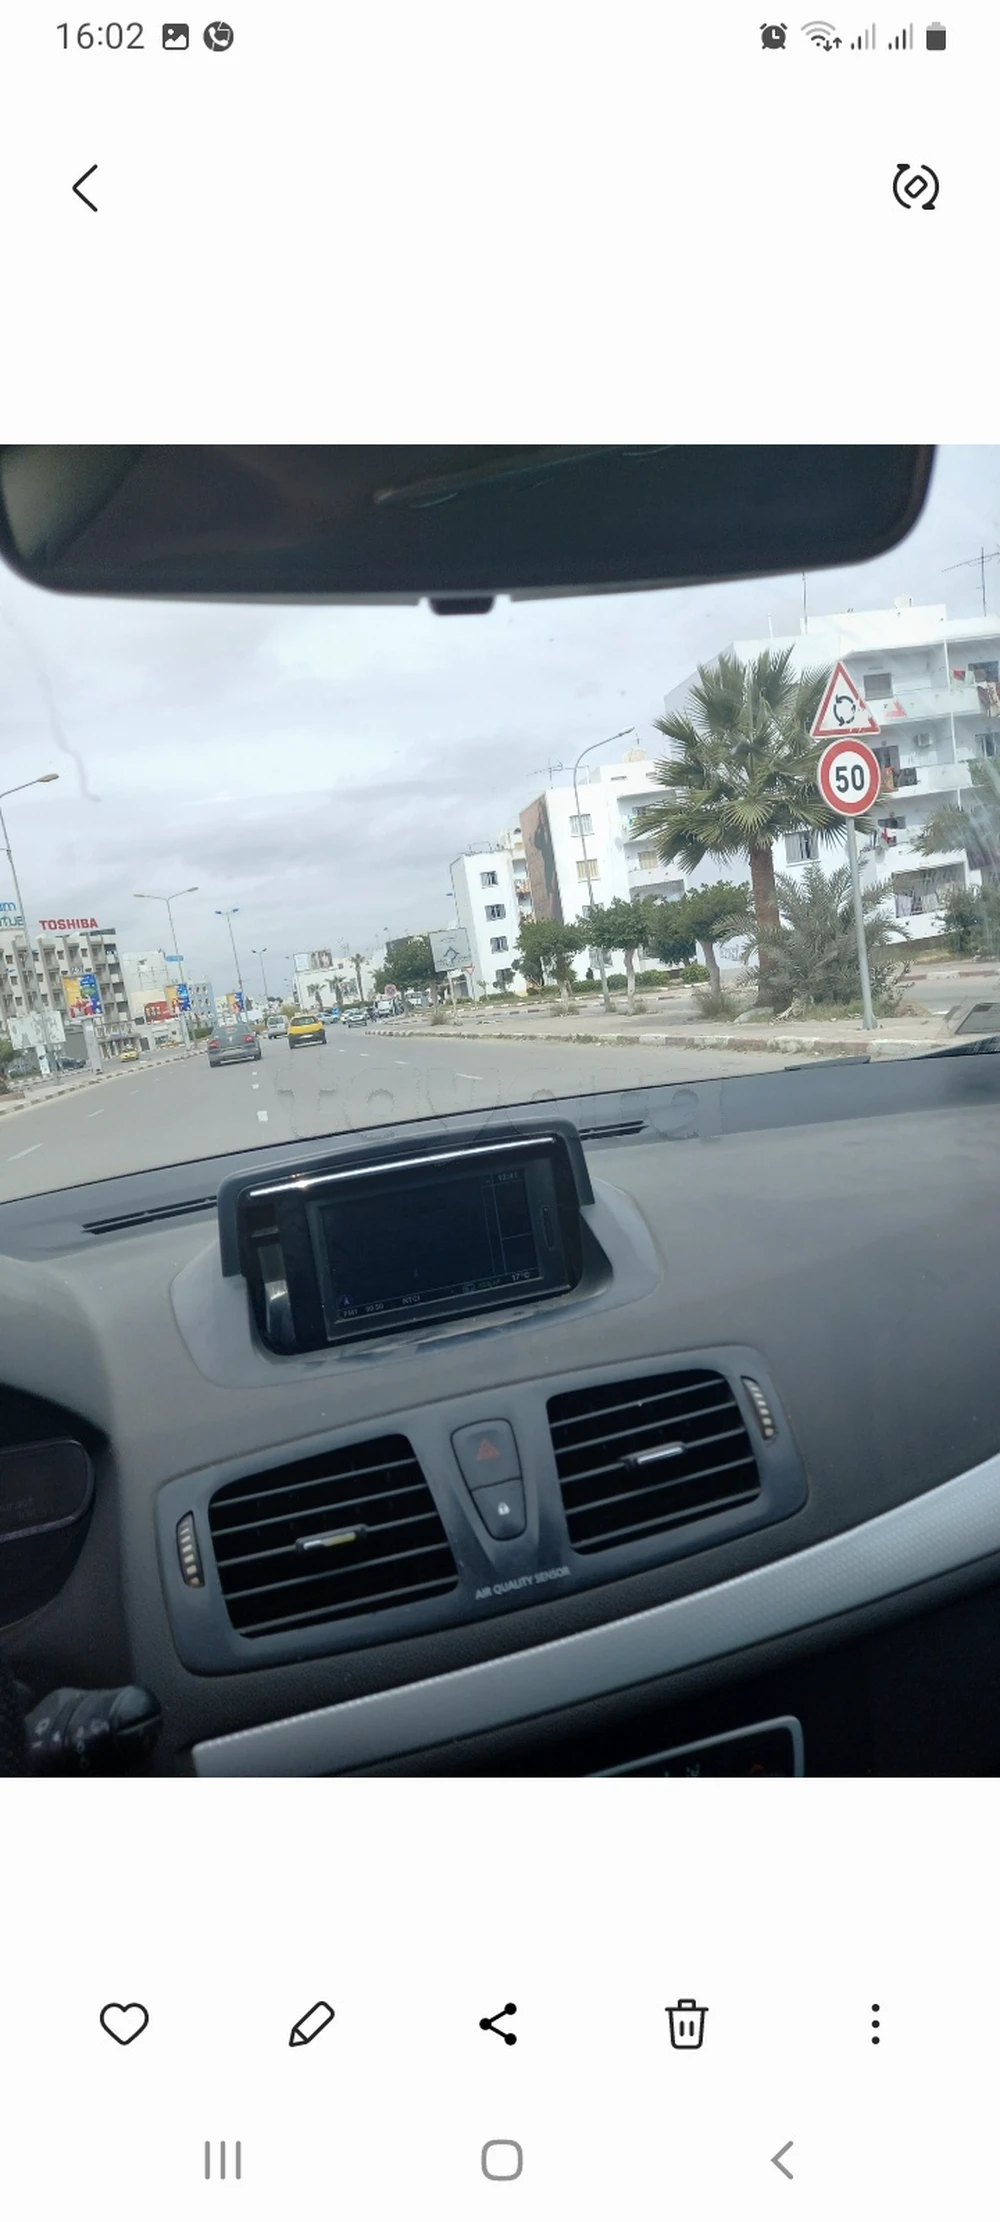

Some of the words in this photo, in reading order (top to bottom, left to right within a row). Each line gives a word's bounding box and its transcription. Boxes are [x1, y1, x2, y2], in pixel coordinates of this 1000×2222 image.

[834, 763, 865, 794] 50
[38, 917, 99, 931] TOSHIBA
[475, 1586, 492, 1600] AIR
[493, 1575, 533, 1595] QUALITY
[534, 1565, 571, 1584] SENSOR
